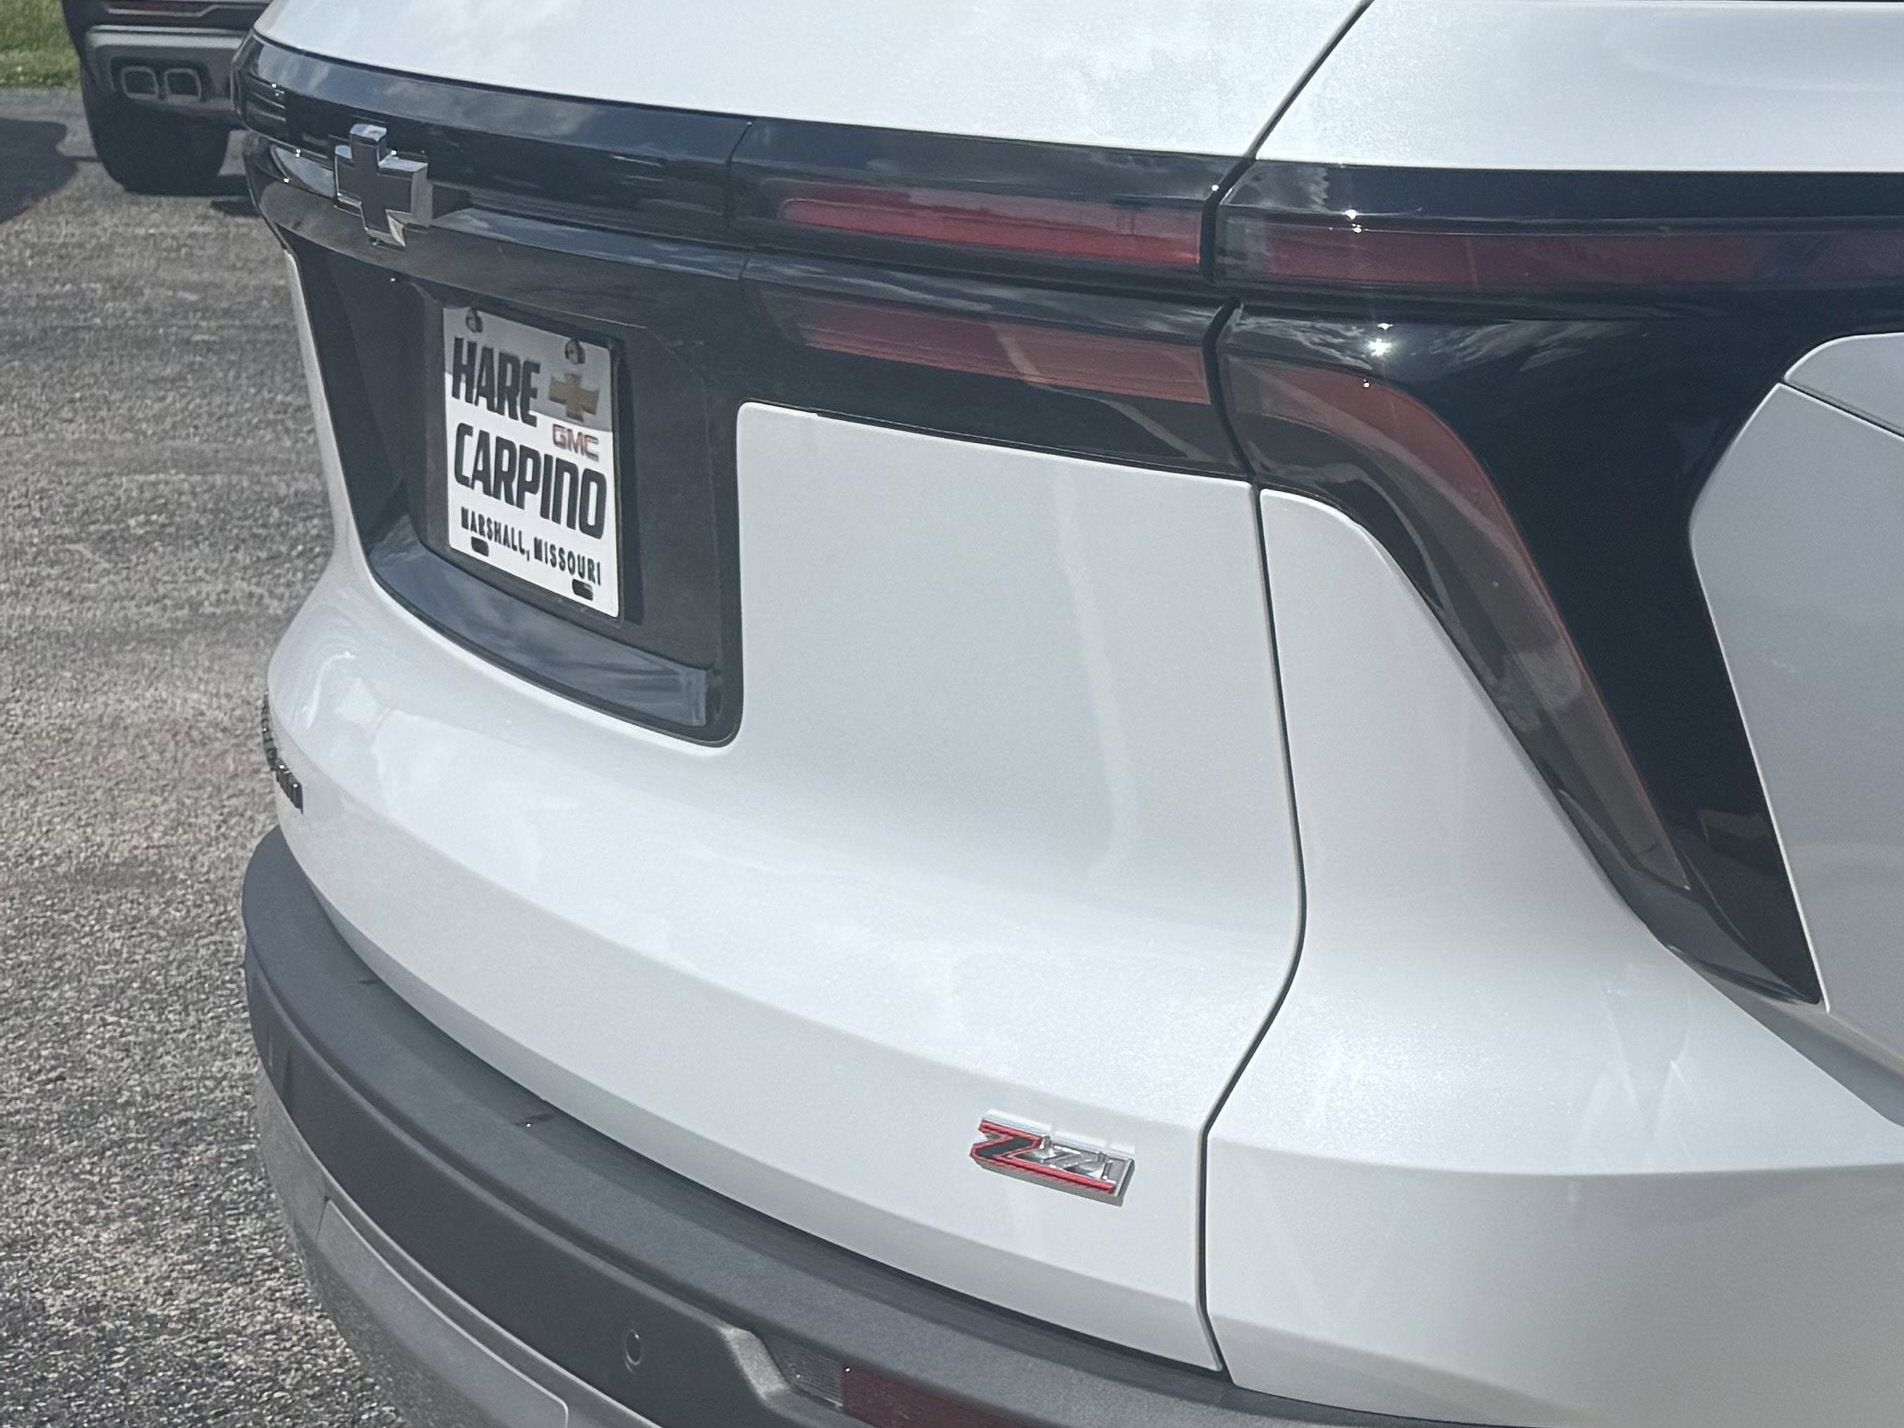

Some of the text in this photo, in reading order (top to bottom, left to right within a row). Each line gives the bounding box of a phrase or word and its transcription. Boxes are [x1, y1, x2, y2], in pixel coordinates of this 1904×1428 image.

[451, 336, 541, 429] HARE
[454, 422, 608, 540] CARPINO
[552, 423, 600, 462] GMC
[460, 506, 602, 586] MARSHALL, MISSOURI
[969, 1118, 1136, 1208] Z71
